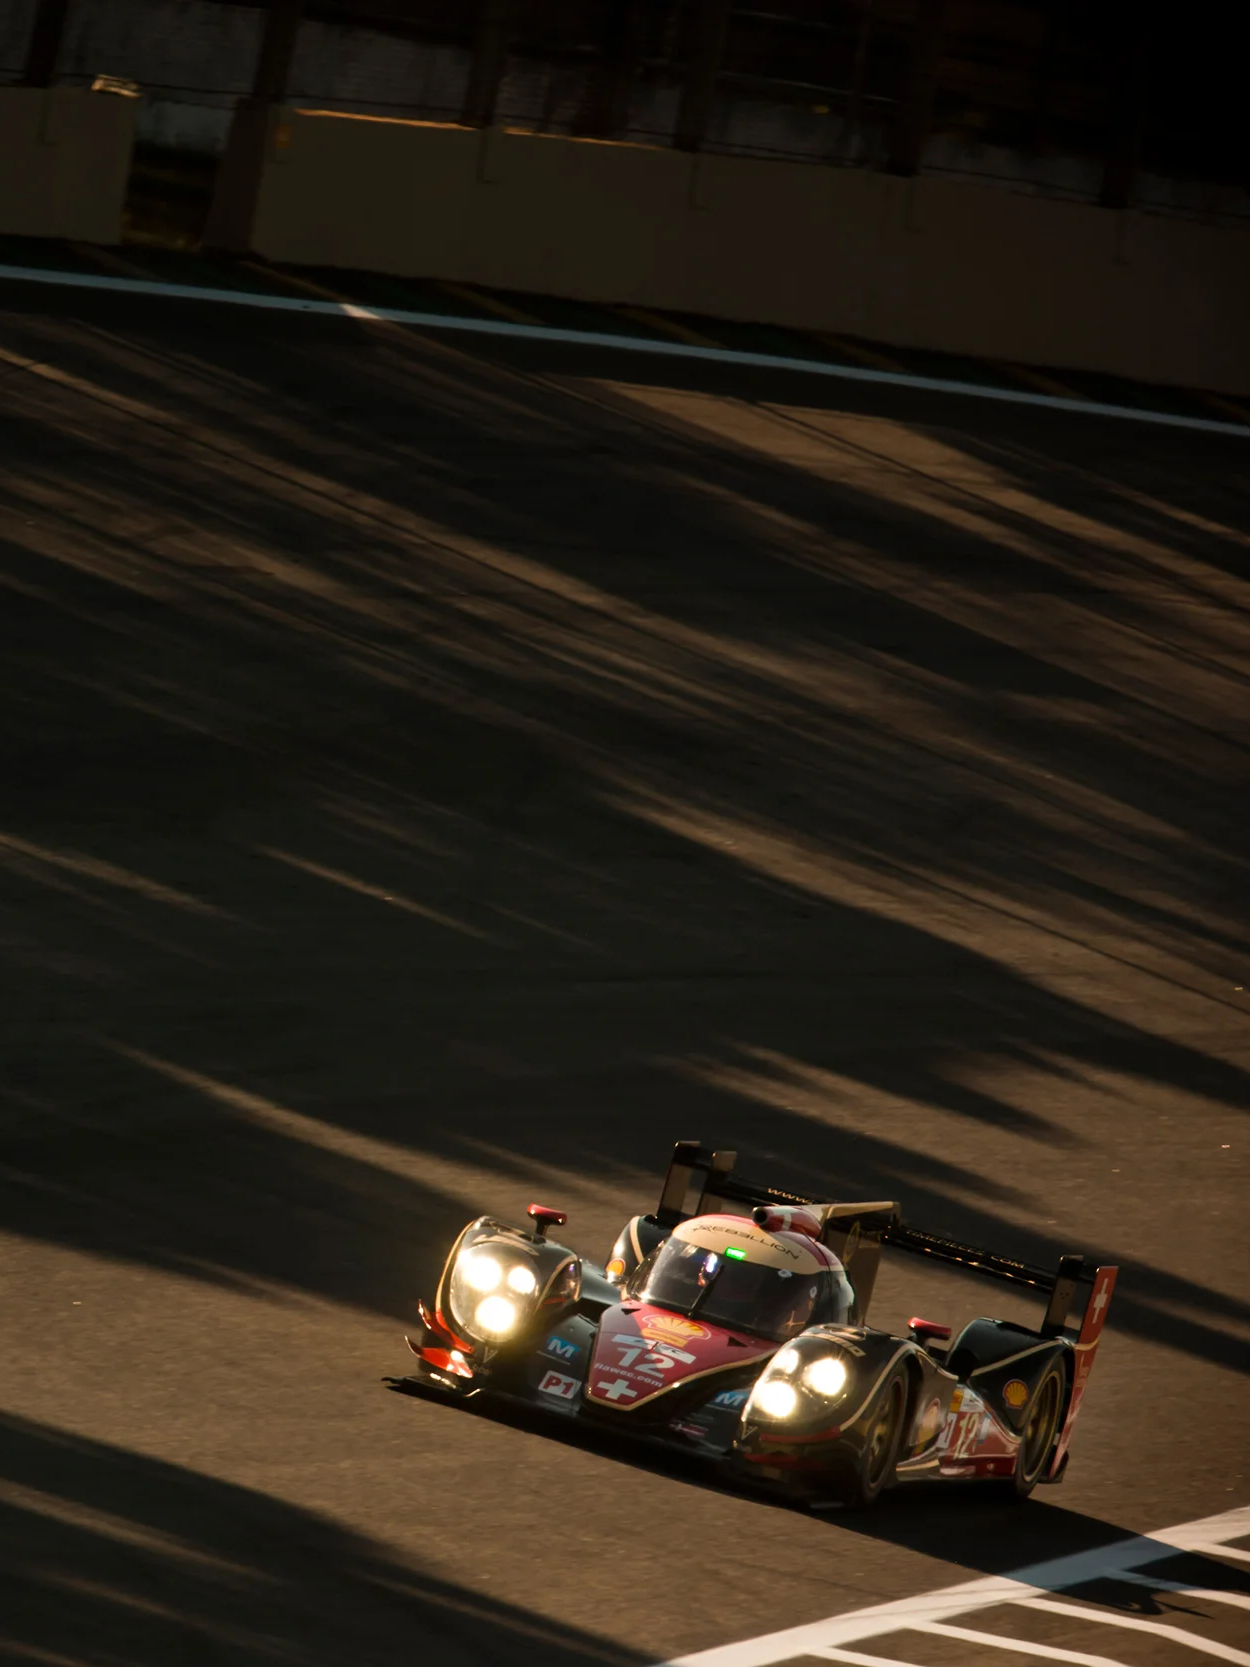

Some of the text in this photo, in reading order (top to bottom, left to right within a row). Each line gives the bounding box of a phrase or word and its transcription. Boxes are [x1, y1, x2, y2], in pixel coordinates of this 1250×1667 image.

[617, 1346, 676, 1379] 12
[543, 1375, 575, 1396] P1
[952, 1412, 980, 1461] 12
